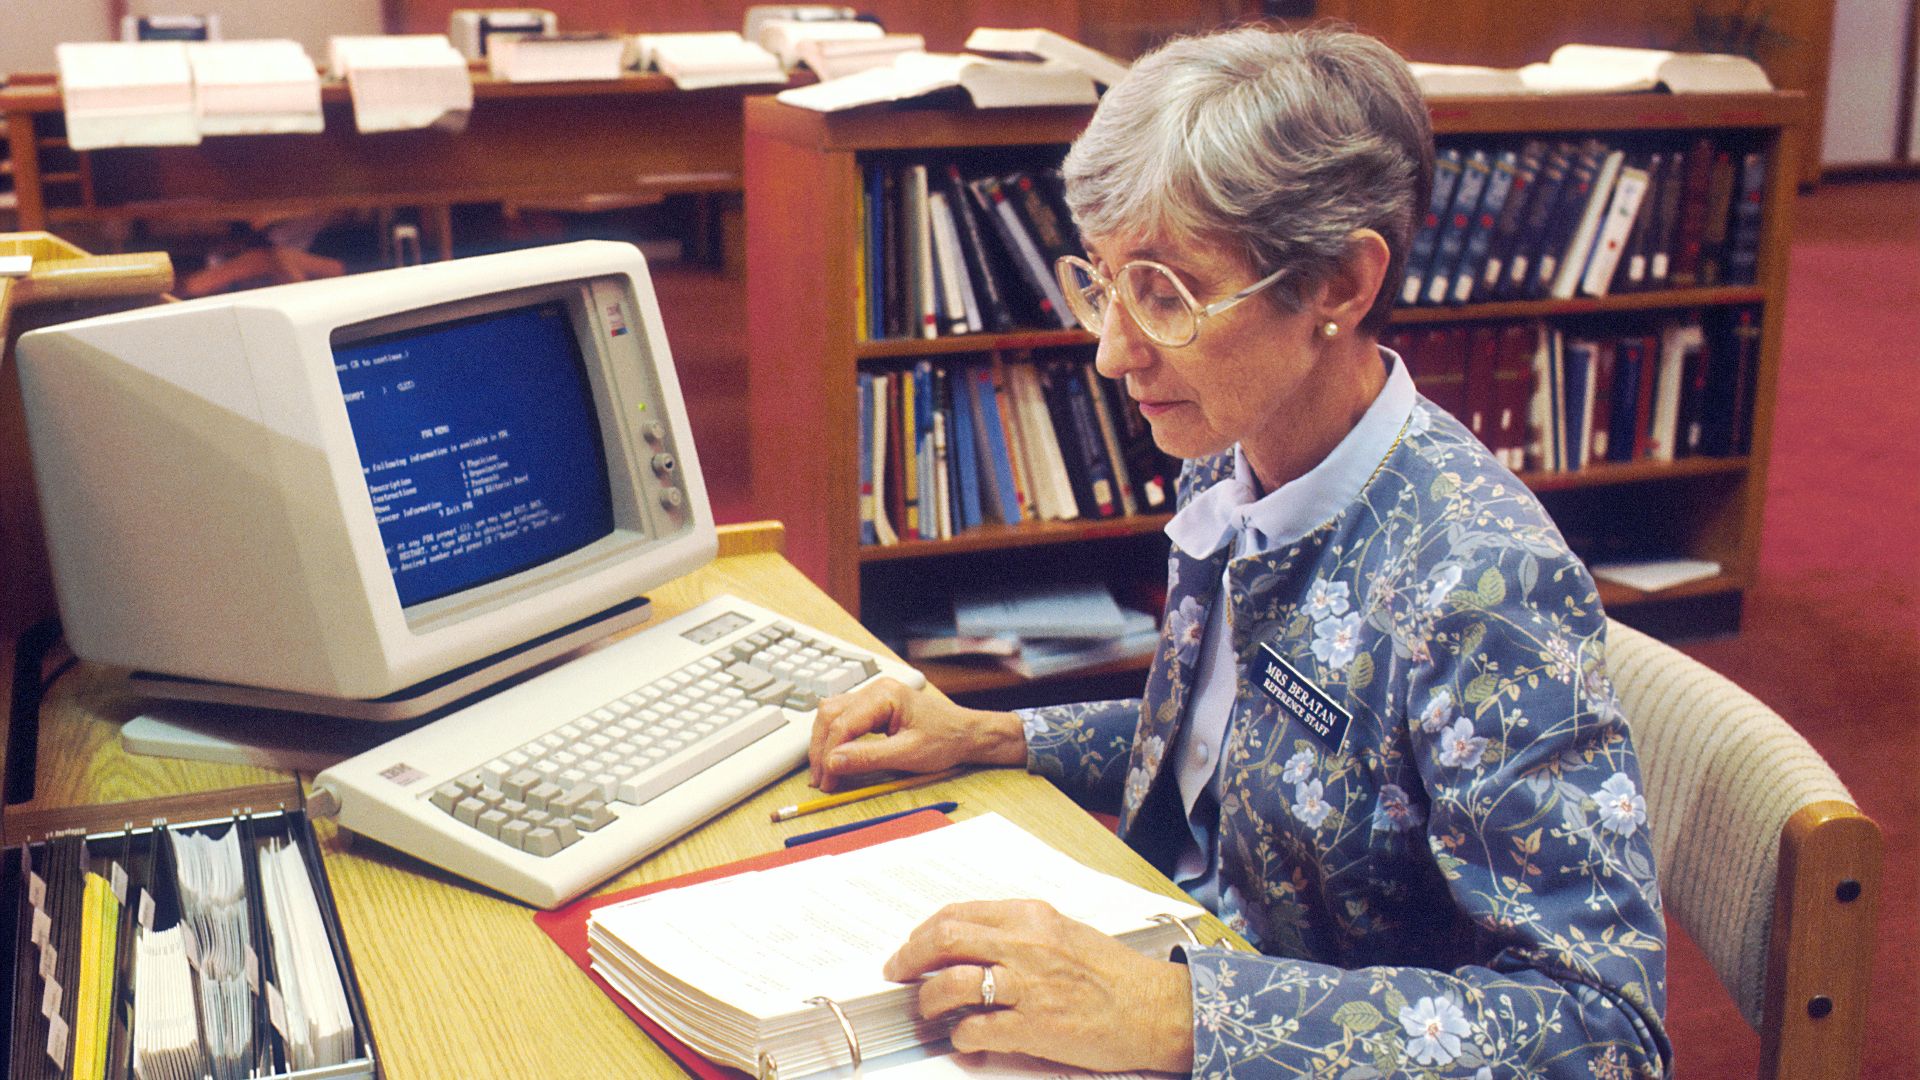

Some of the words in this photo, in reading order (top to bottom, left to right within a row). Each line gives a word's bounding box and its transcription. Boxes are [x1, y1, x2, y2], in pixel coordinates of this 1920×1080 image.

[372, 458, 407, 472] following
[410, 448, 448, 463] information
[370, 478, 412, 494] Description
[372, 487, 417, 504] Instructions
[1265, 662, 1288, 687] MRS
[1288, 681, 1337, 727] BERATAN
[1262, 678, 1306, 718] REFERENCE
[1304, 712, 1330, 737] STAFF
